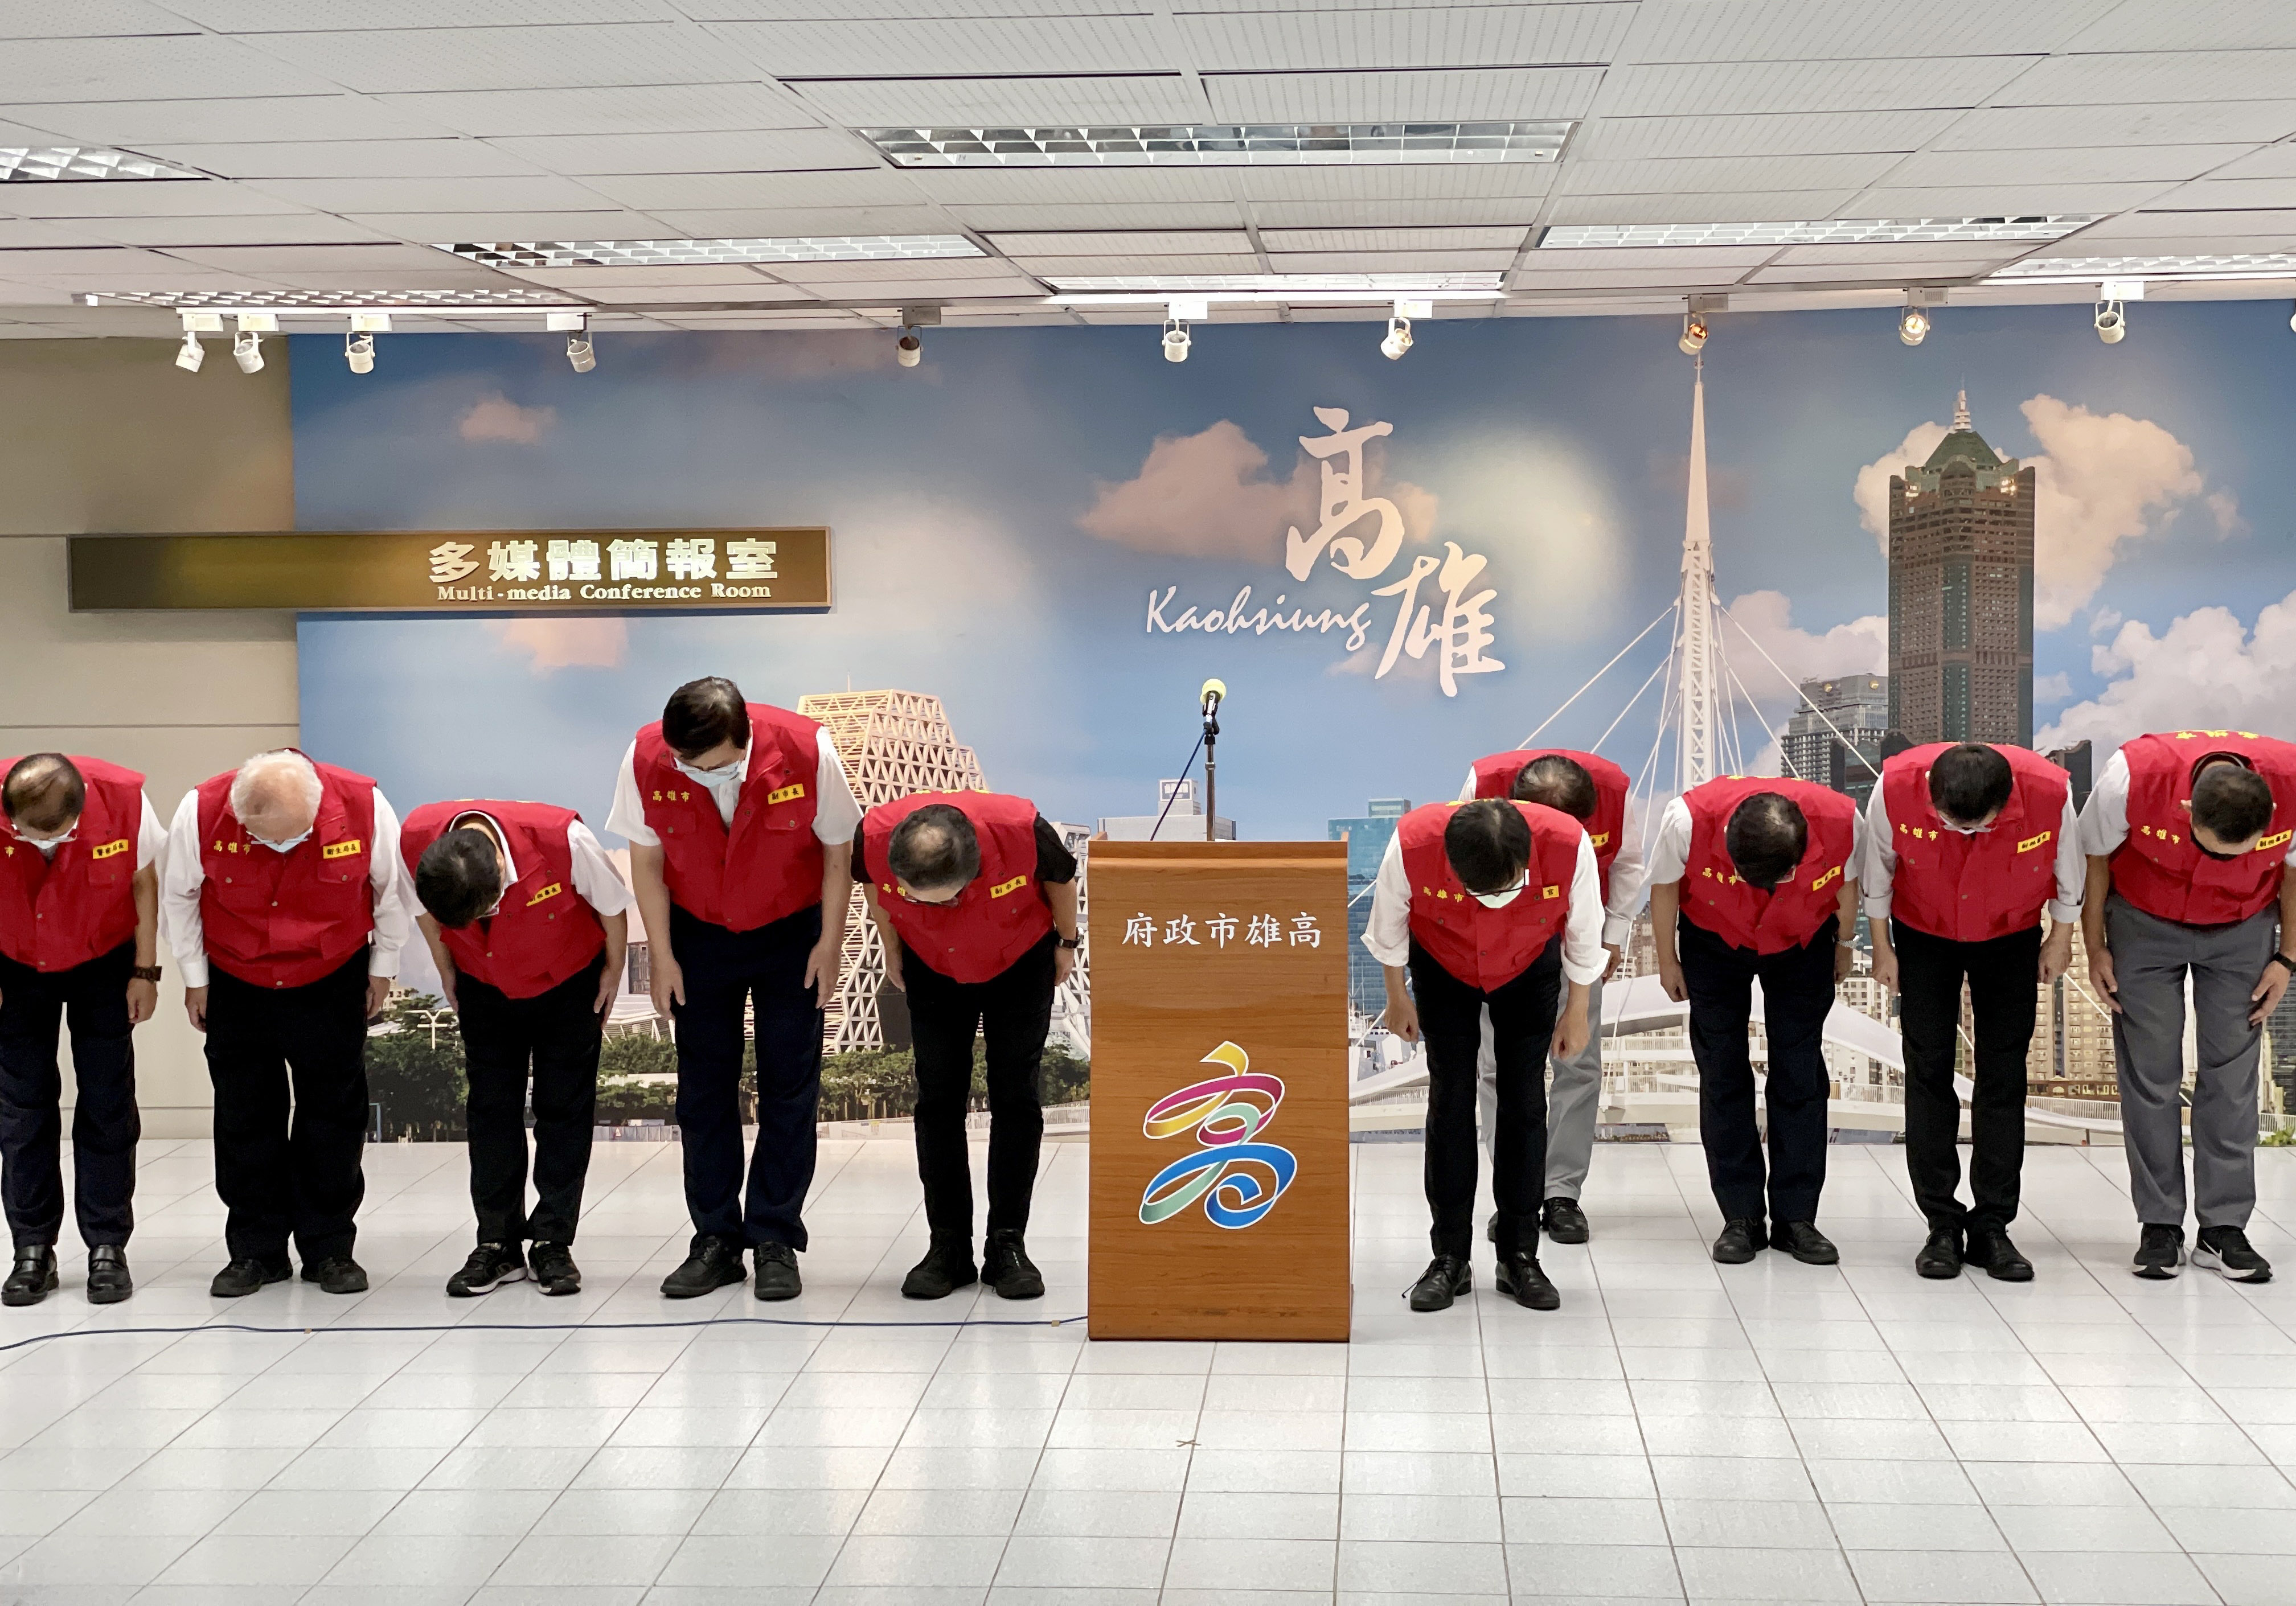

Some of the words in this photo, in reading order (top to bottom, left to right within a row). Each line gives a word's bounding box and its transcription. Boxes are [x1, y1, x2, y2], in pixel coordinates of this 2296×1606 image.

[429, 538, 778, 583] 多媒體簡報室
[1285, 406, 1506, 697] 高雄
[437, 584, 571, 601] Multi-media
[580, 584, 702, 599] Conference
[710, 582, 772, 598] Room
[1146, 585, 1371, 651] Kaohsiung
[652, 790, 690, 803] 高雄市
[213, 840, 251, 855] 高雄市
[883, 883, 906, 897] 高雄
[1122, 911, 1322, 949] 高雄市政府
